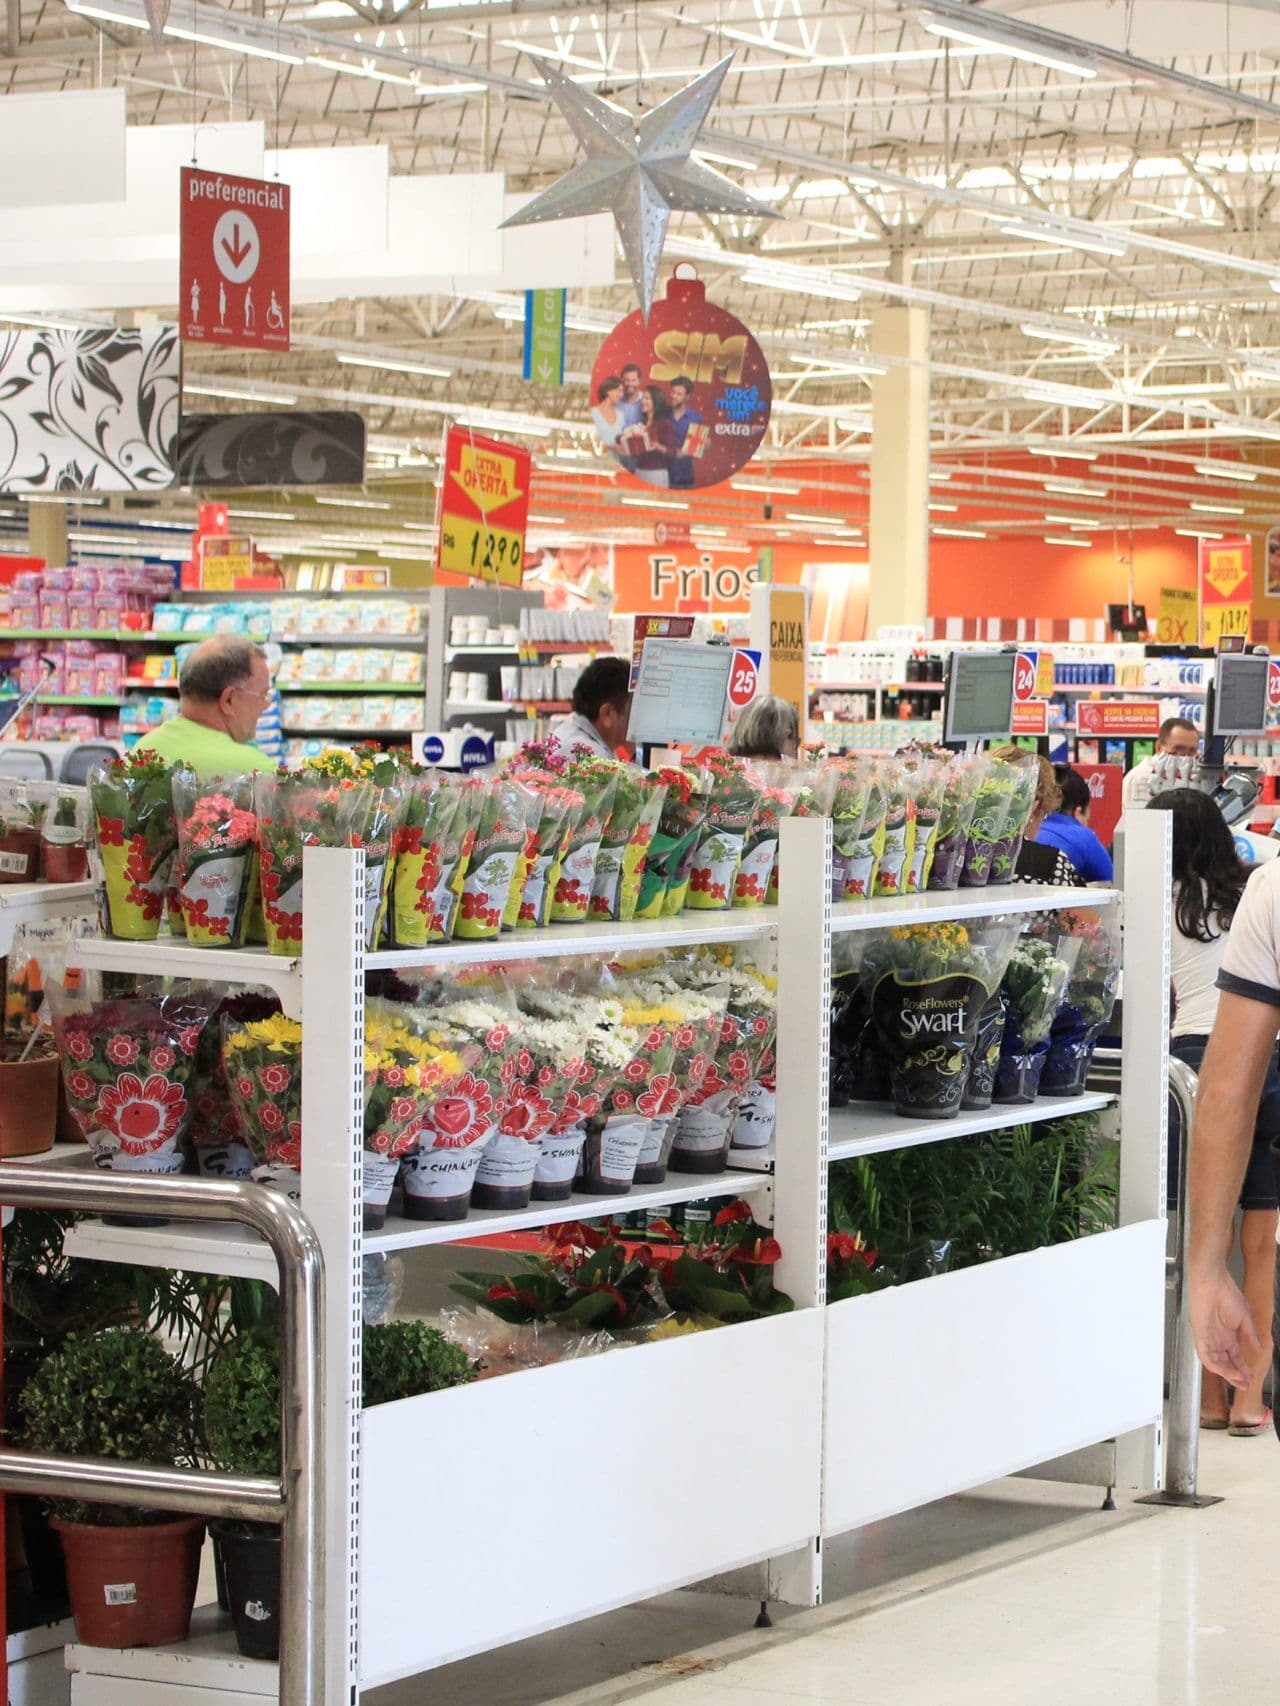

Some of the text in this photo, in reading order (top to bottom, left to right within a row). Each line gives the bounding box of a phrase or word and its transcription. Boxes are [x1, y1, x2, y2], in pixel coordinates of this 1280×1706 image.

[189, 178, 284, 210] preferencial
[650, 329, 747, 384] SIM
[715, 423, 750, 436] extra
[464, 469, 507, 497] OFERTA
[771, 620, 804, 648] CAIXA
[733, 669, 756, 693] 25
[1016, 669, 1033, 690] 24
[1269, 676, 1280, 694] 23
[424, 745, 442, 754] NIVEA
[463, 752, 487, 764] NIVEA
[901, 1007, 967, 1035] Swart
